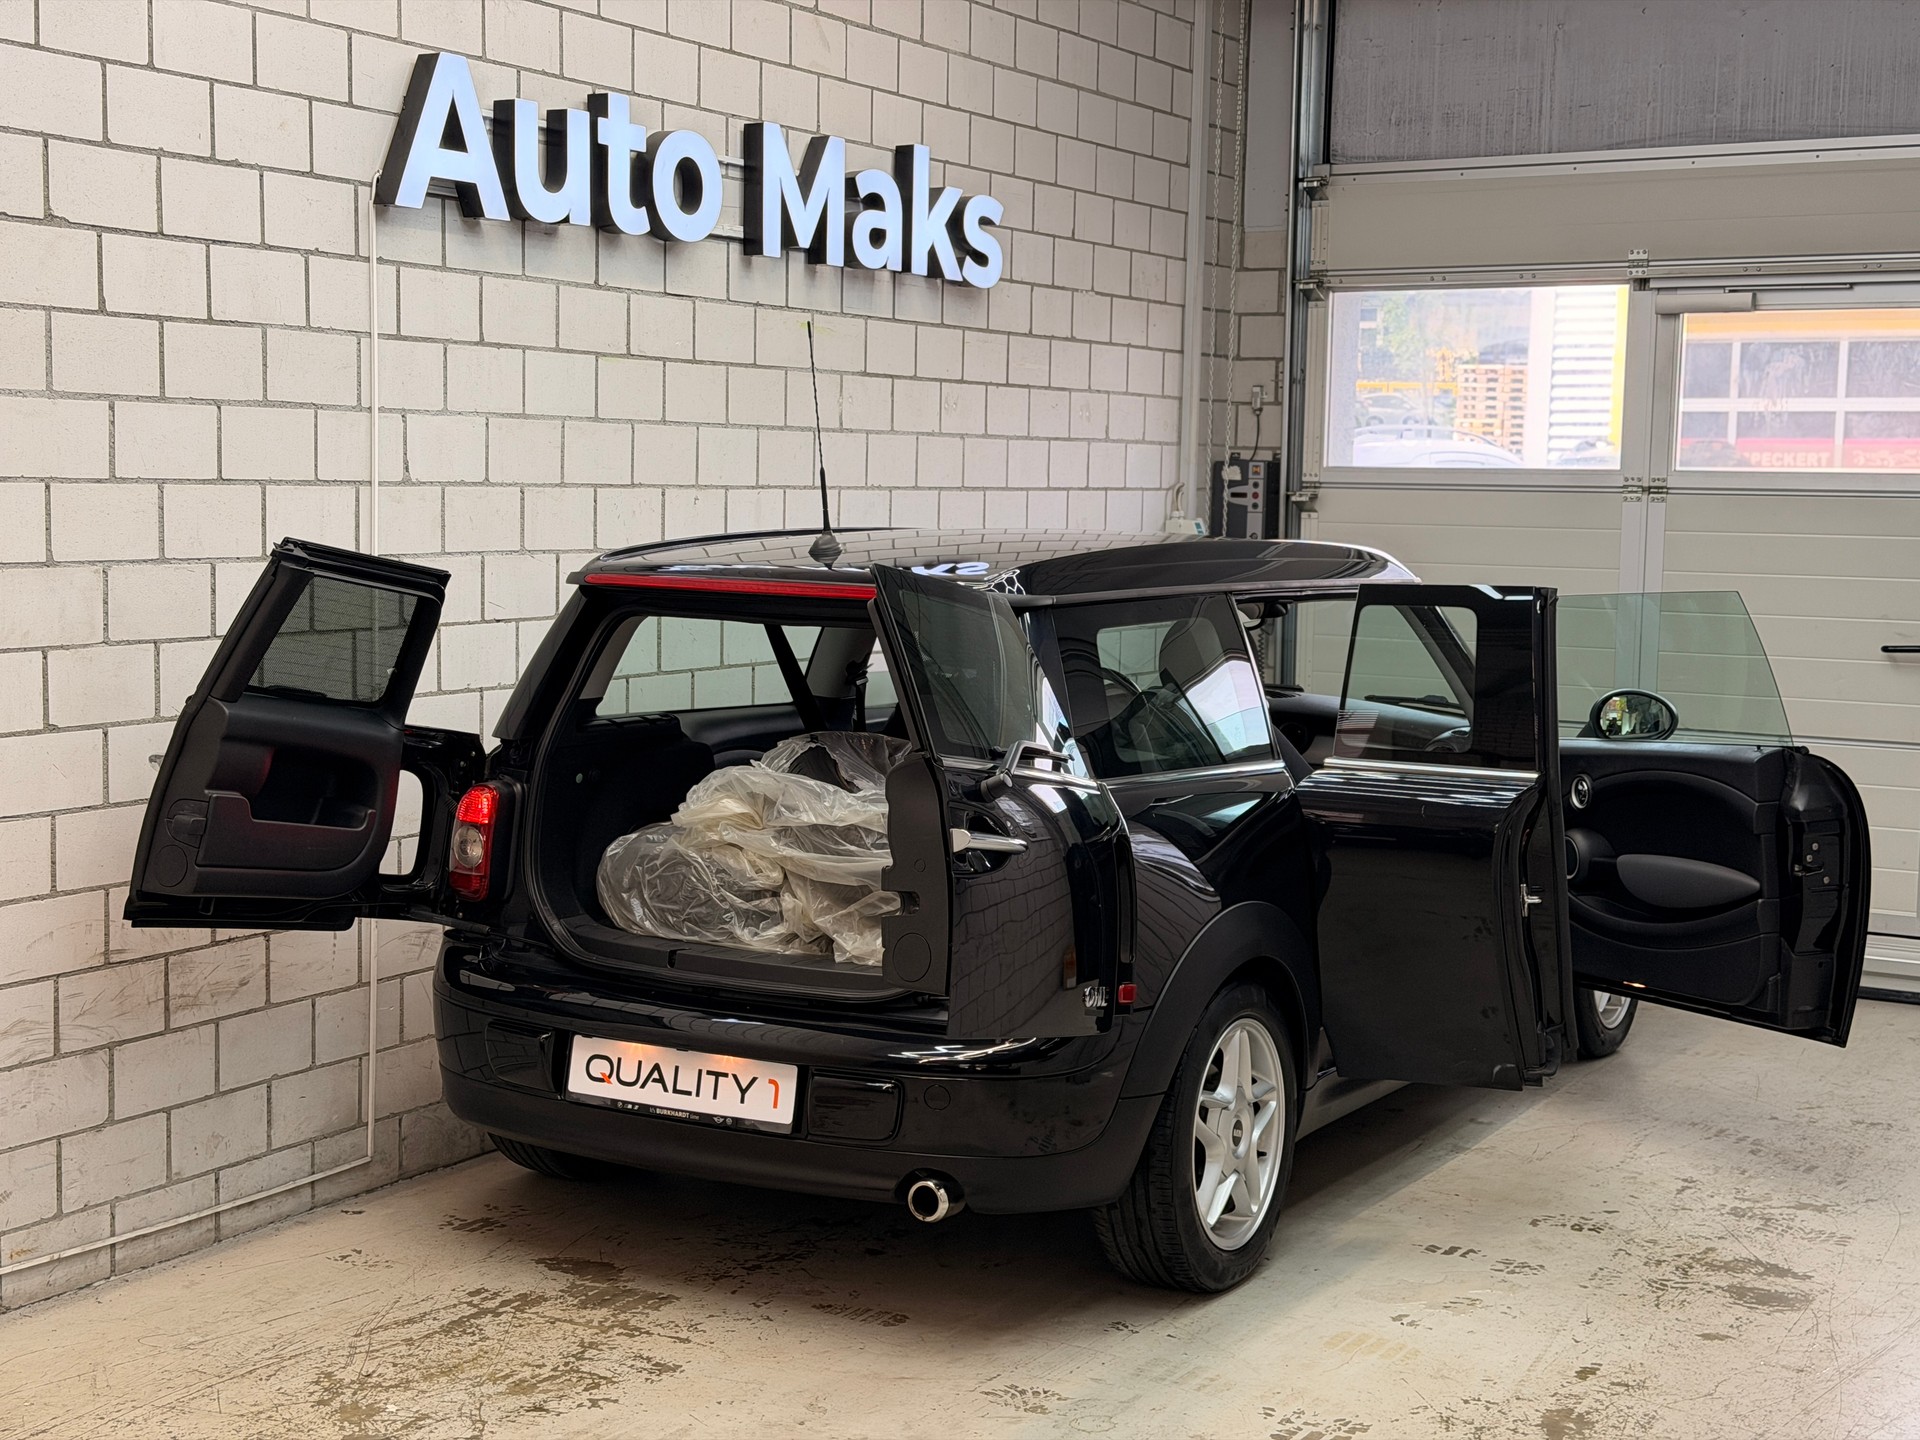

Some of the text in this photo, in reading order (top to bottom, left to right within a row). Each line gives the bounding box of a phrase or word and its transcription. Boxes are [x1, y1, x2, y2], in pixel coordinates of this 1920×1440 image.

[377, 52, 1005, 290] Auto Maks
[1743, 450, 1831, 467] PECKERT
[585, 1053, 780, 1110] QUALITY 1
[656, 1107, 690, 1119] BURKHARDT
